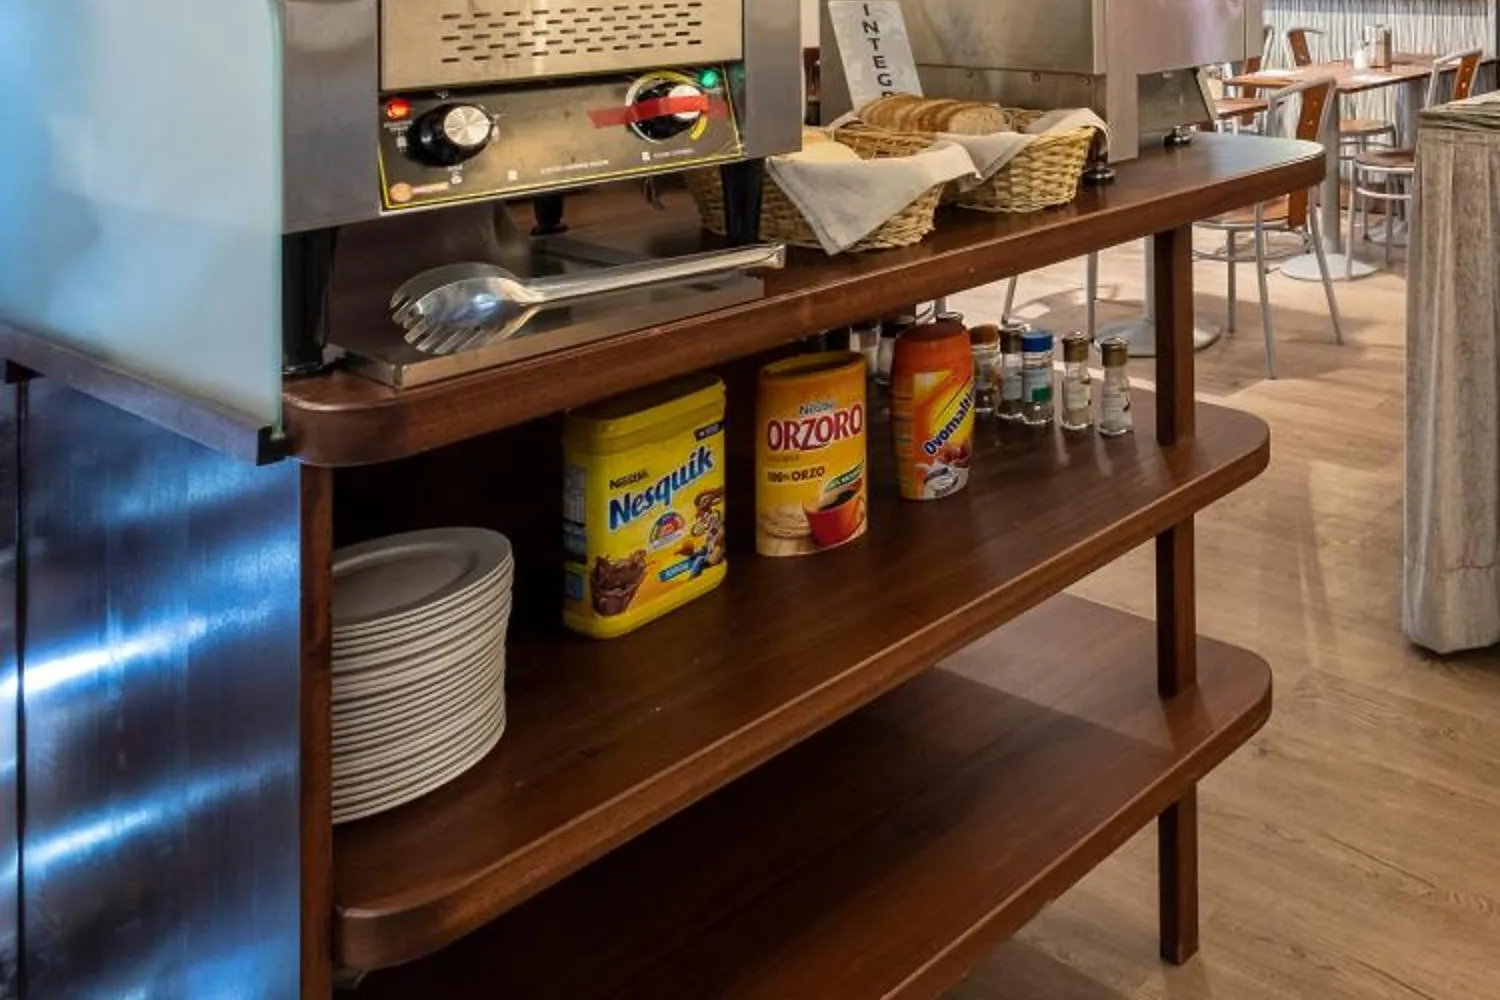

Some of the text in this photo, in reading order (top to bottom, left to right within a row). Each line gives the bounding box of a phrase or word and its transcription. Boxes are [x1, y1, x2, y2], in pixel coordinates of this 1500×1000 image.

[767, 403, 863, 451] ORZORO
[609, 446, 714, 531] Nesquik
[792, 466, 825, 481] ORZO
